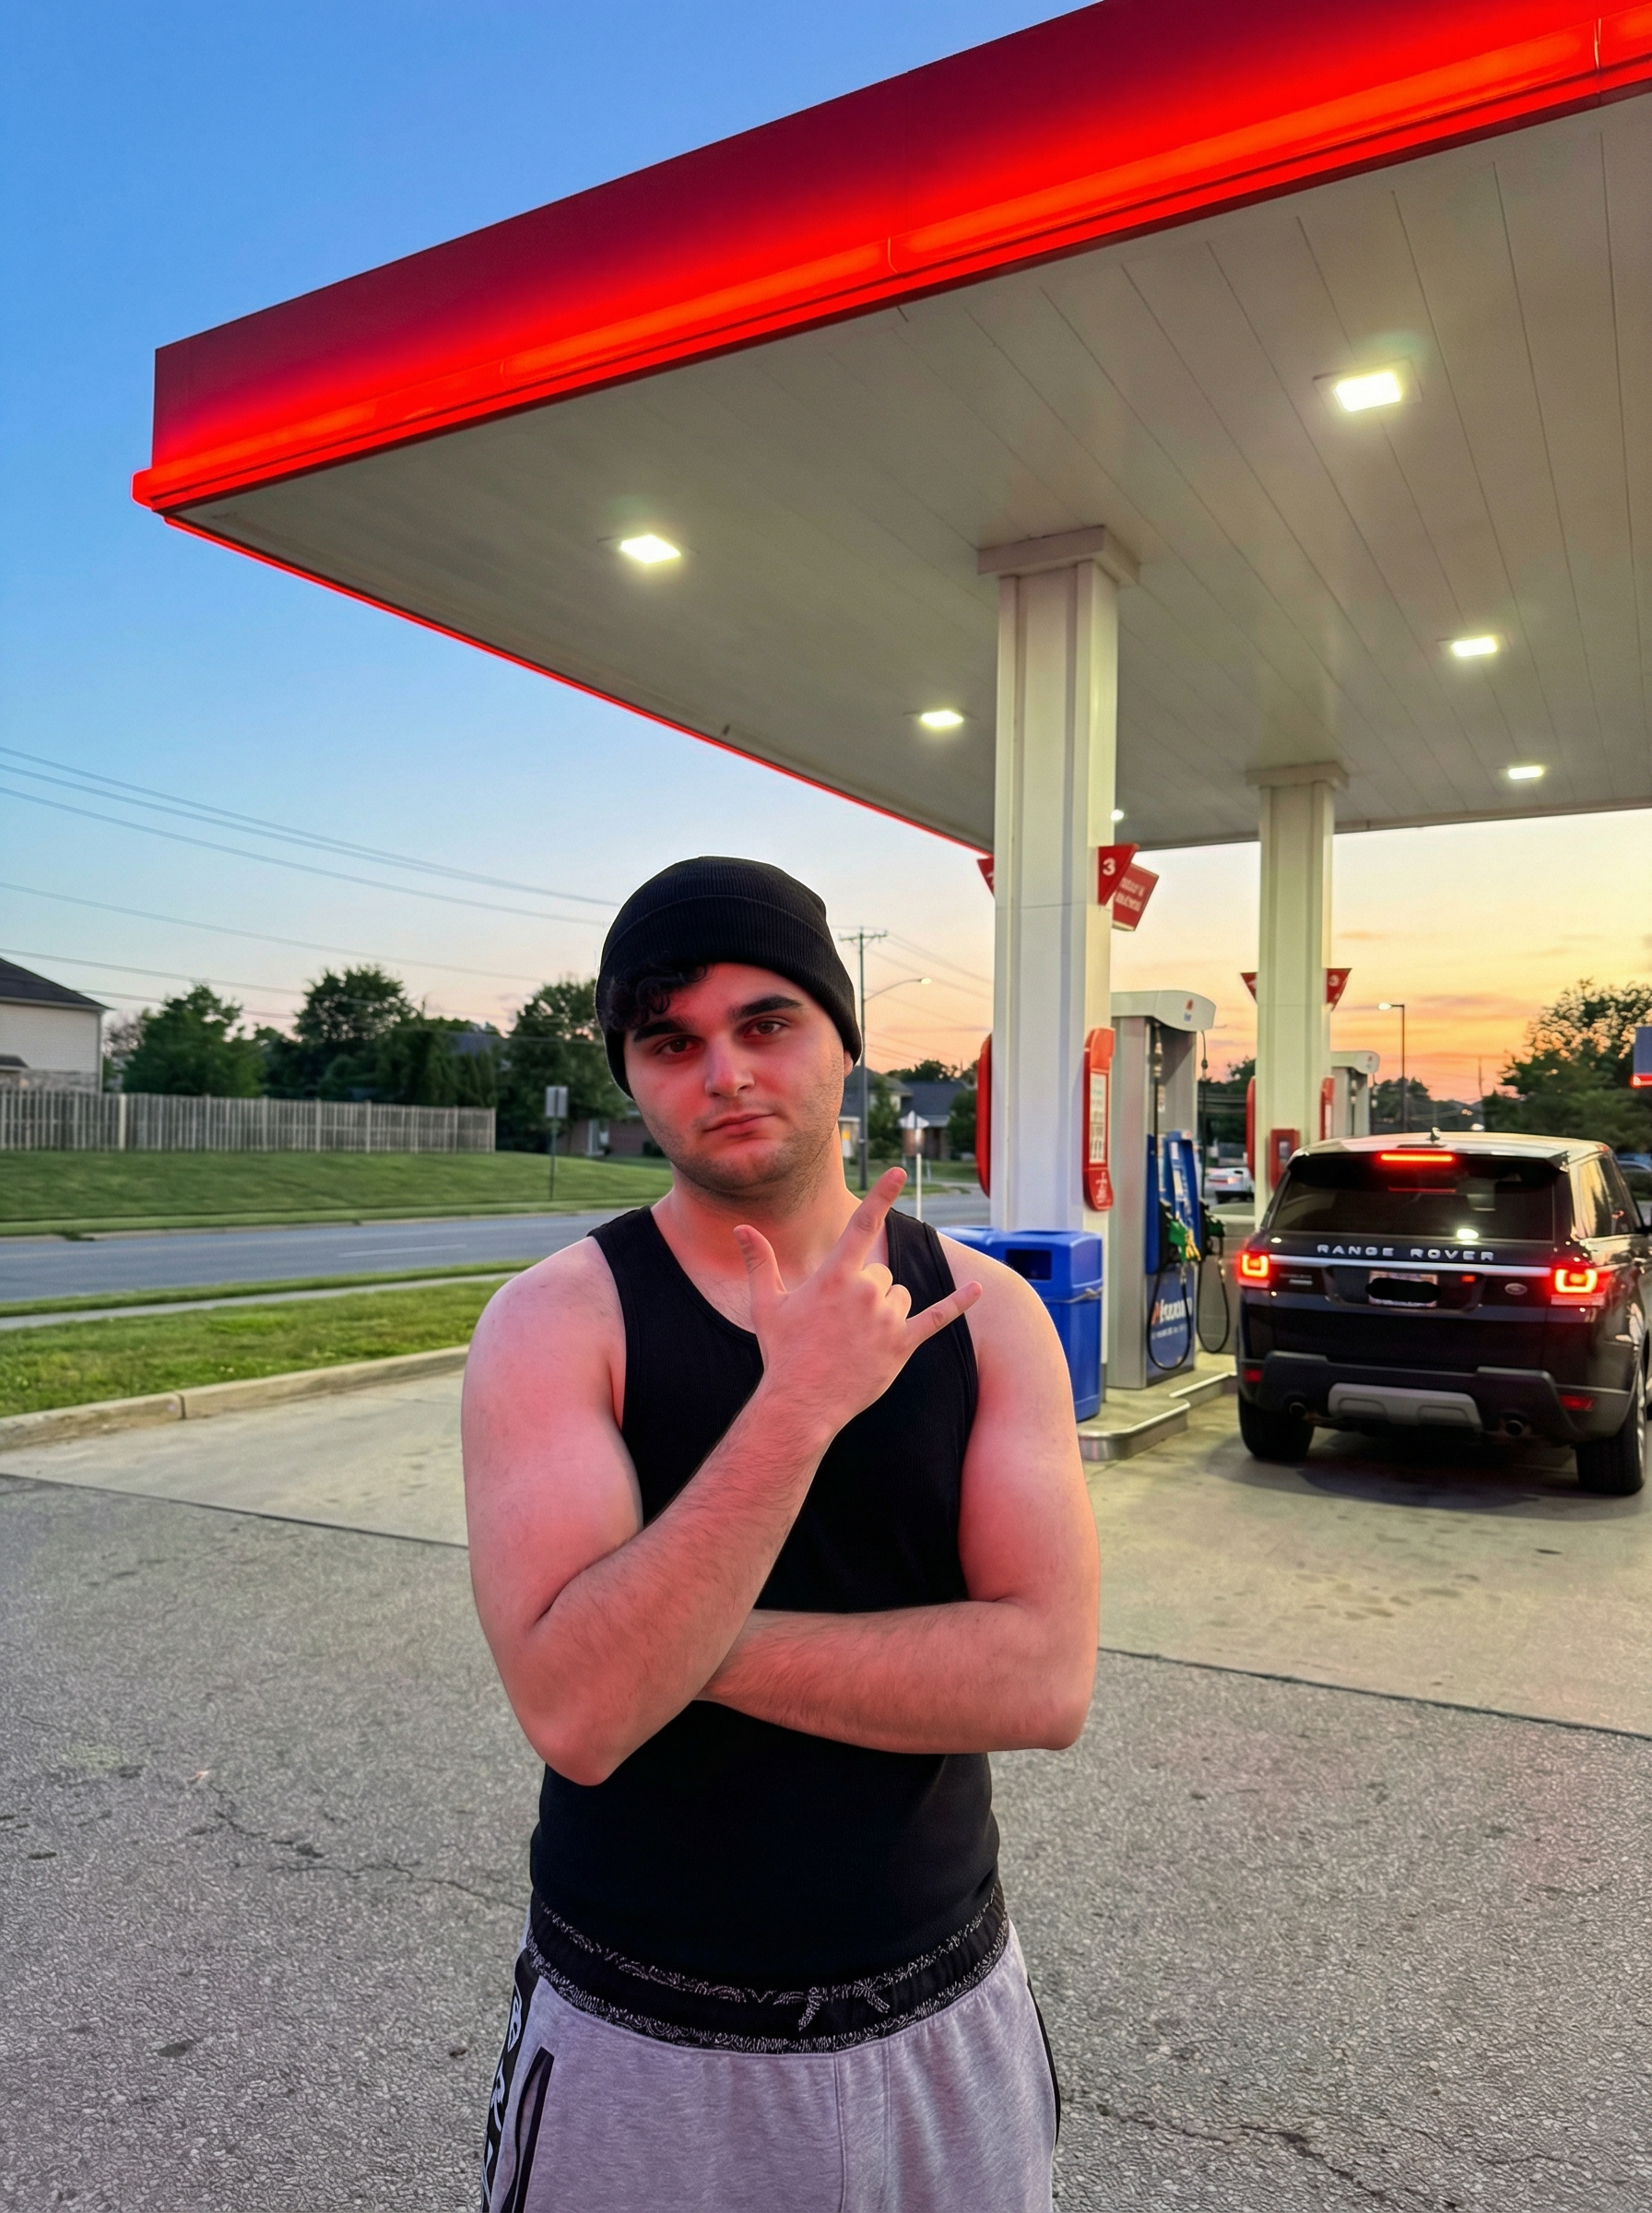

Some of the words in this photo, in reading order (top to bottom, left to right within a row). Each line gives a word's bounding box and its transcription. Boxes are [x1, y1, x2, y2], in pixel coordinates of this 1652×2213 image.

[1103, 858, 1115, 876] 3
[1316, 1244, 1395, 1257] RANGE
[1410, 1248, 1494, 1261] ROVER
